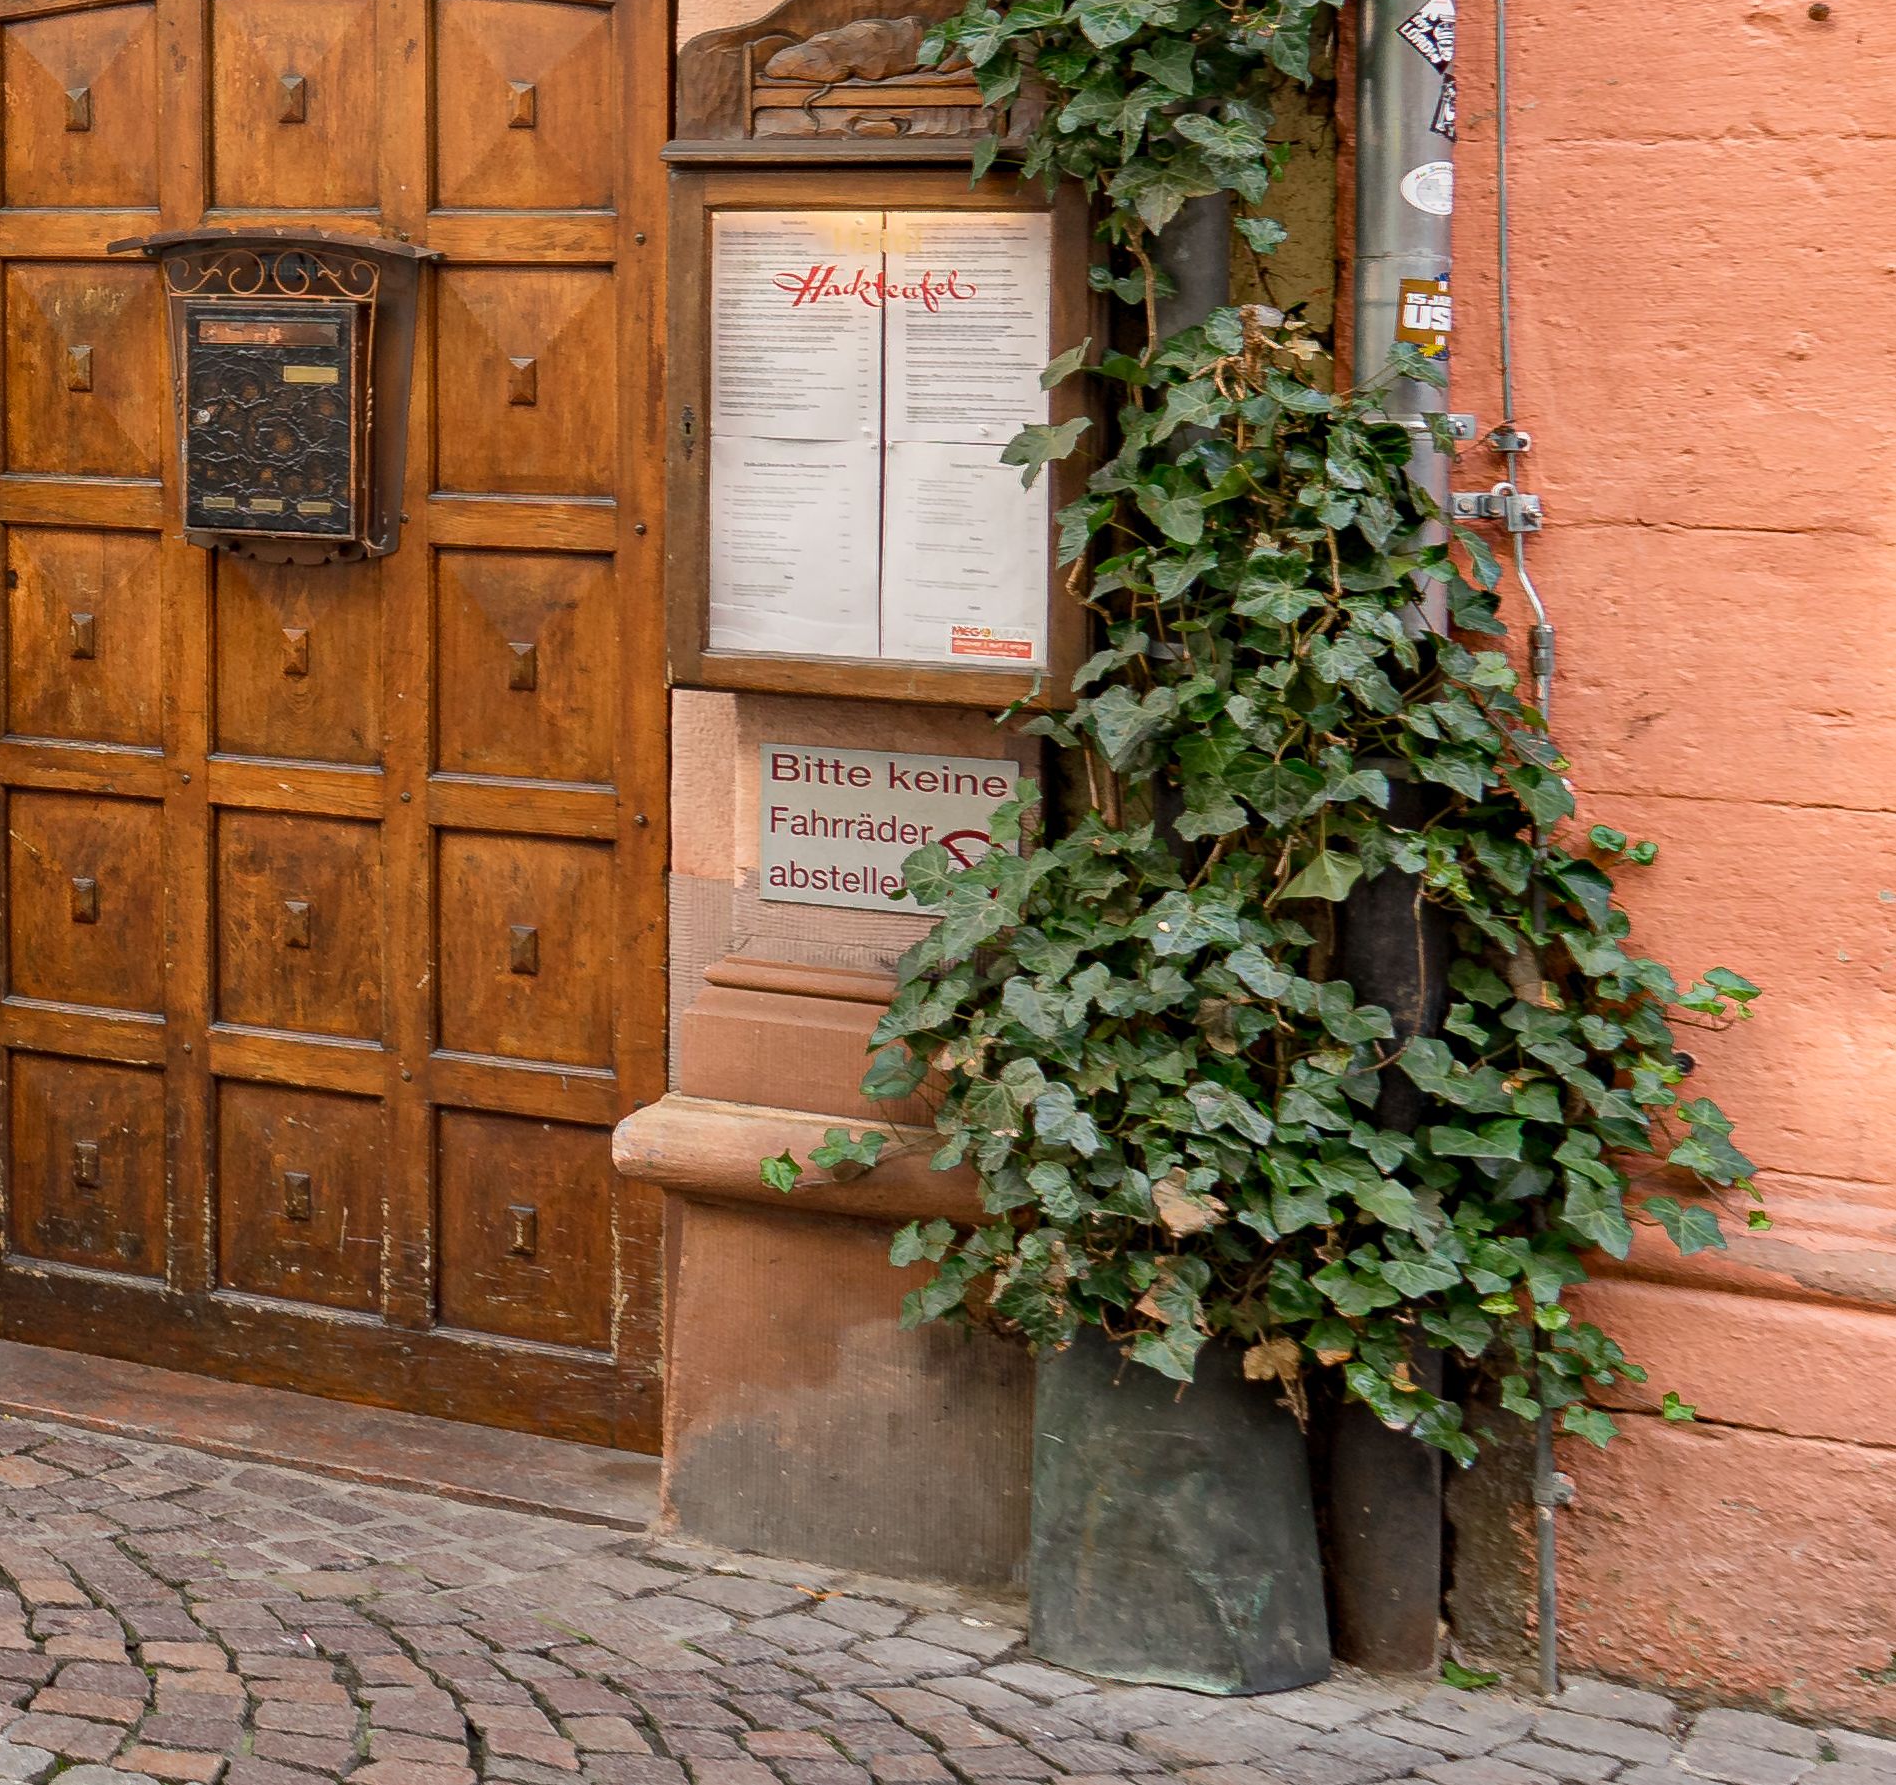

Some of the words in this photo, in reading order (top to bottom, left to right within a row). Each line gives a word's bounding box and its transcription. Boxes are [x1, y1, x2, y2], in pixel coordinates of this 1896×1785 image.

[773, 263, 977, 313] Hackteufel
[771, 753, 872, 787] Bitte
[889, 762, 1008, 798] keine
[770, 806, 934, 846] Fahrräder
[770, 861, 906, 897] abstelle
